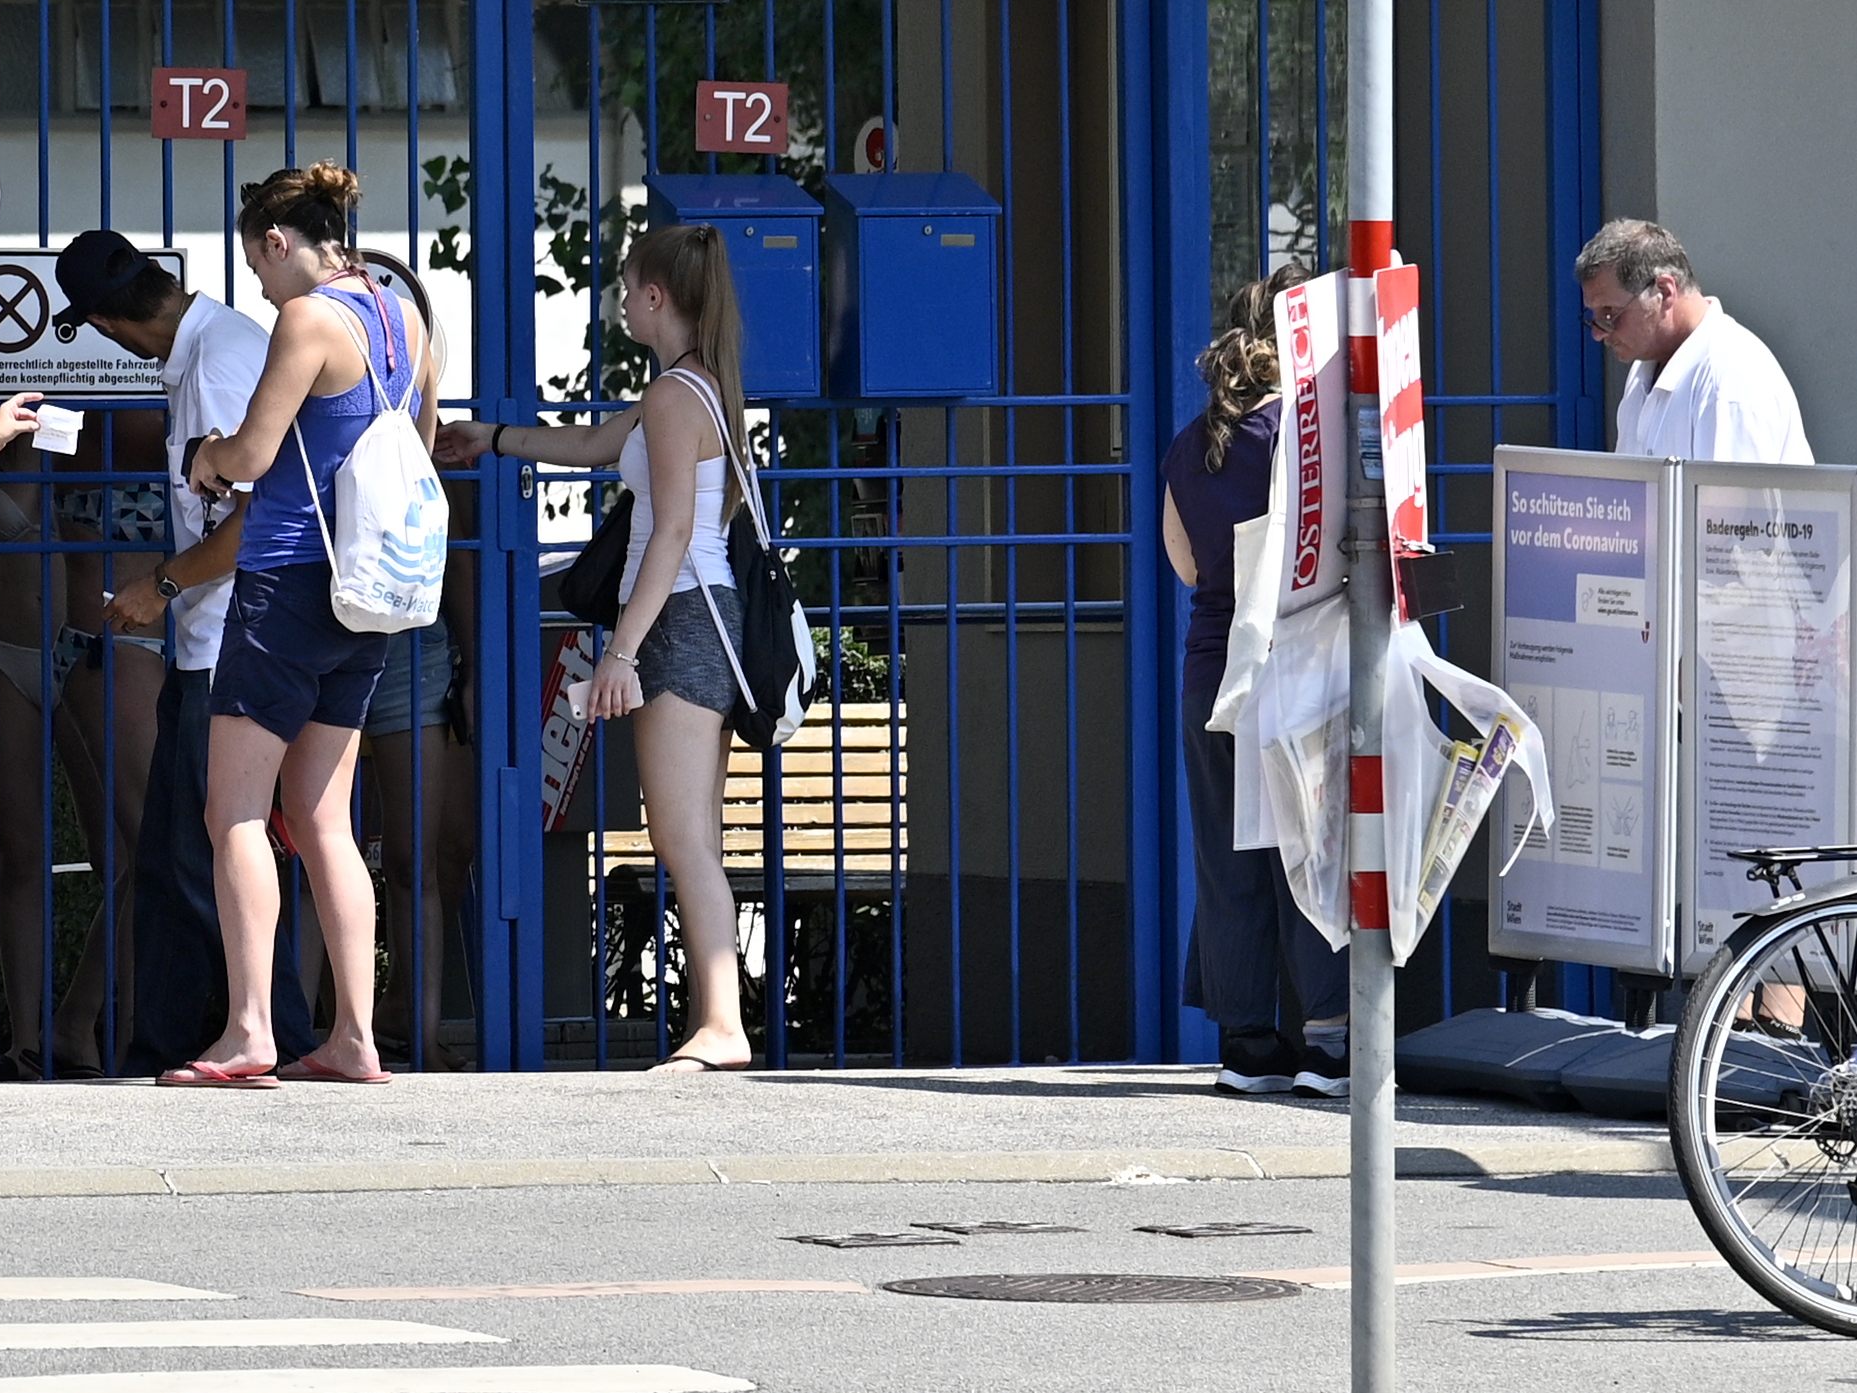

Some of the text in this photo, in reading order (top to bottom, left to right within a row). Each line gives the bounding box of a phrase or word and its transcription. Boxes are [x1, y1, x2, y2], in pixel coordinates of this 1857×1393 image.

[168, 77, 231, 129] T2
[713, 91, 773, 144] T2
[56, 358, 113, 372] abgestellte
[20, 372, 95, 386] kostenpflichtig
[1287, 288, 1322, 589] ÖSTERREICH
[1511, 491, 1631, 522] So schützen Sie sich
[1706, 519, 1759, 542] Baderegeln
[1766, 521, 1814, 540] COVID-19
[1511, 525, 1639, 555] vor dem Coronavirus
[1507, 901, 1522, 912] Stadt
[1506, 912, 1522, 925] Wien
[1698, 920, 1715, 933] Stadt
[1698, 933, 1714, 947] Wien
